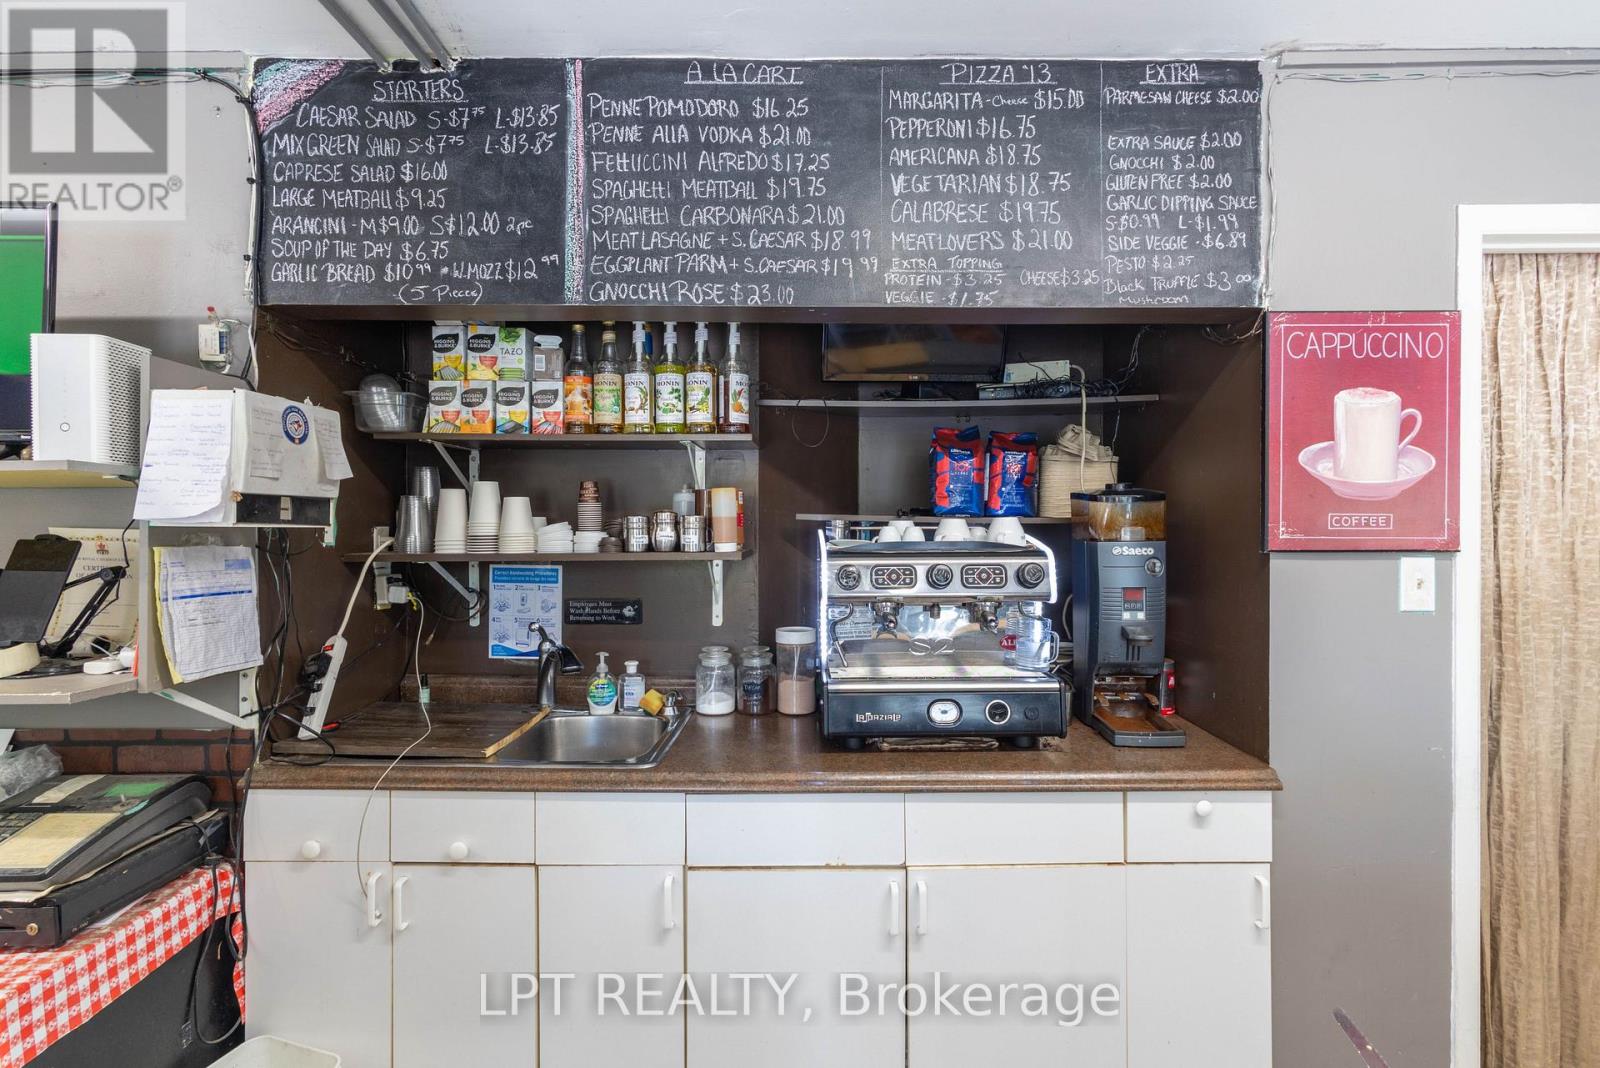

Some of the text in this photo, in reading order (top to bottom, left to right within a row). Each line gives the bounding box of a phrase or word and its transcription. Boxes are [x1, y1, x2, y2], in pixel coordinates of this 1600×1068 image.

[687, 60, 803, 83] A LA CART
[941, 63, 1015, 84] PIZZA
[1145, 63, 1199, 82] EXTRA
[373, 79, 465, 101] STARTERS
[889, 89, 984, 110] MARGARITA
[1034, 88, 1085, 110] $15.00
[1103, 86, 1260, 106] PARMESAN CHEESE $2.00
[296, 103, 360, 128] CAESAR
[365, 107, 416, 129] SALAD
[587, 93, 643, 118] PENNE
[642, 95, 740, 118] POMODORO
[587, 122, 812, 148] PENNE ALLA VODKA $21.00
[885, 115, 1036, 140] PEPPERONI $16.75
[272, 132, 304, 157] MIX
[307, 133, 360, 157] GREEN
[366, 134, 400, 157] SALAD
[1107, 131, 1243, 150] EXTRA SAUCE $2.00
[592, 151, 831, 173] FETTUCCINI ALFREDO $17.25
[889, 143, 1042, 167] AMERICANA $18.75
[1109, 154, 1215, 171] GNOCCHI $2.00
[273, 161, 448, 185] CAPRESE SALAD $16.00
[1105, 172, 1233, 191] GLUTEN FREE $2.00
[592, 176, 827, 201] SPAGHETTI MEATBALL $19.75
[890, 171, 1072, 197] VEGETARIAN $18.75
[272, 186, 448, 212] LARGE MEATBALL $9.25
[1106, 194, 1258, 212] GARLIC DIPPING SAUCE
[591, 203, 845, 226] SPAGHETTI CARBONARA $21.00
[891, 199, 990, 224] CALABRESE
[271, 216, 347, 235] ARANCINI
[592, 230, 638, 251] MEAT
[641, 230, 715, 250] LASAGNE
[1012, 228, 1073, 252] $21.00
[1108, 235, 1141, 251] SIDE
[1145, 235, 1190, 250] VEGGIE
[271, 238, 449, 264] SOUP OF THE DAY $6.75
[271, 262, 318, 283] GARLIC
[321, 263, 376, 283] BREAD
[590, 256, 672, 275] EGGPLANT
[672, 254, 728, 275] PARM
[892, 254, 1003, 270] EXTRA TOPPING
[1104, 255, 1146, 274] PESTO
[884, 273, 942, 287] PROTEIN
[1020, 269, 1061, 286] CHEESE
[1150, 273, 1200, 291] TRUFFLE
[589, 280, 795, 305] GNOCCHI ROSE $23.00
[885, 291, 935, 305] VEGGIE
[500, 347, 524, 356] TAZO
[1286, 331, 1444, 359] CAPPUCCINO
[1332, 515, 1387, 528] COFFEE
[1122, 546, 1155, 556] Saeco
